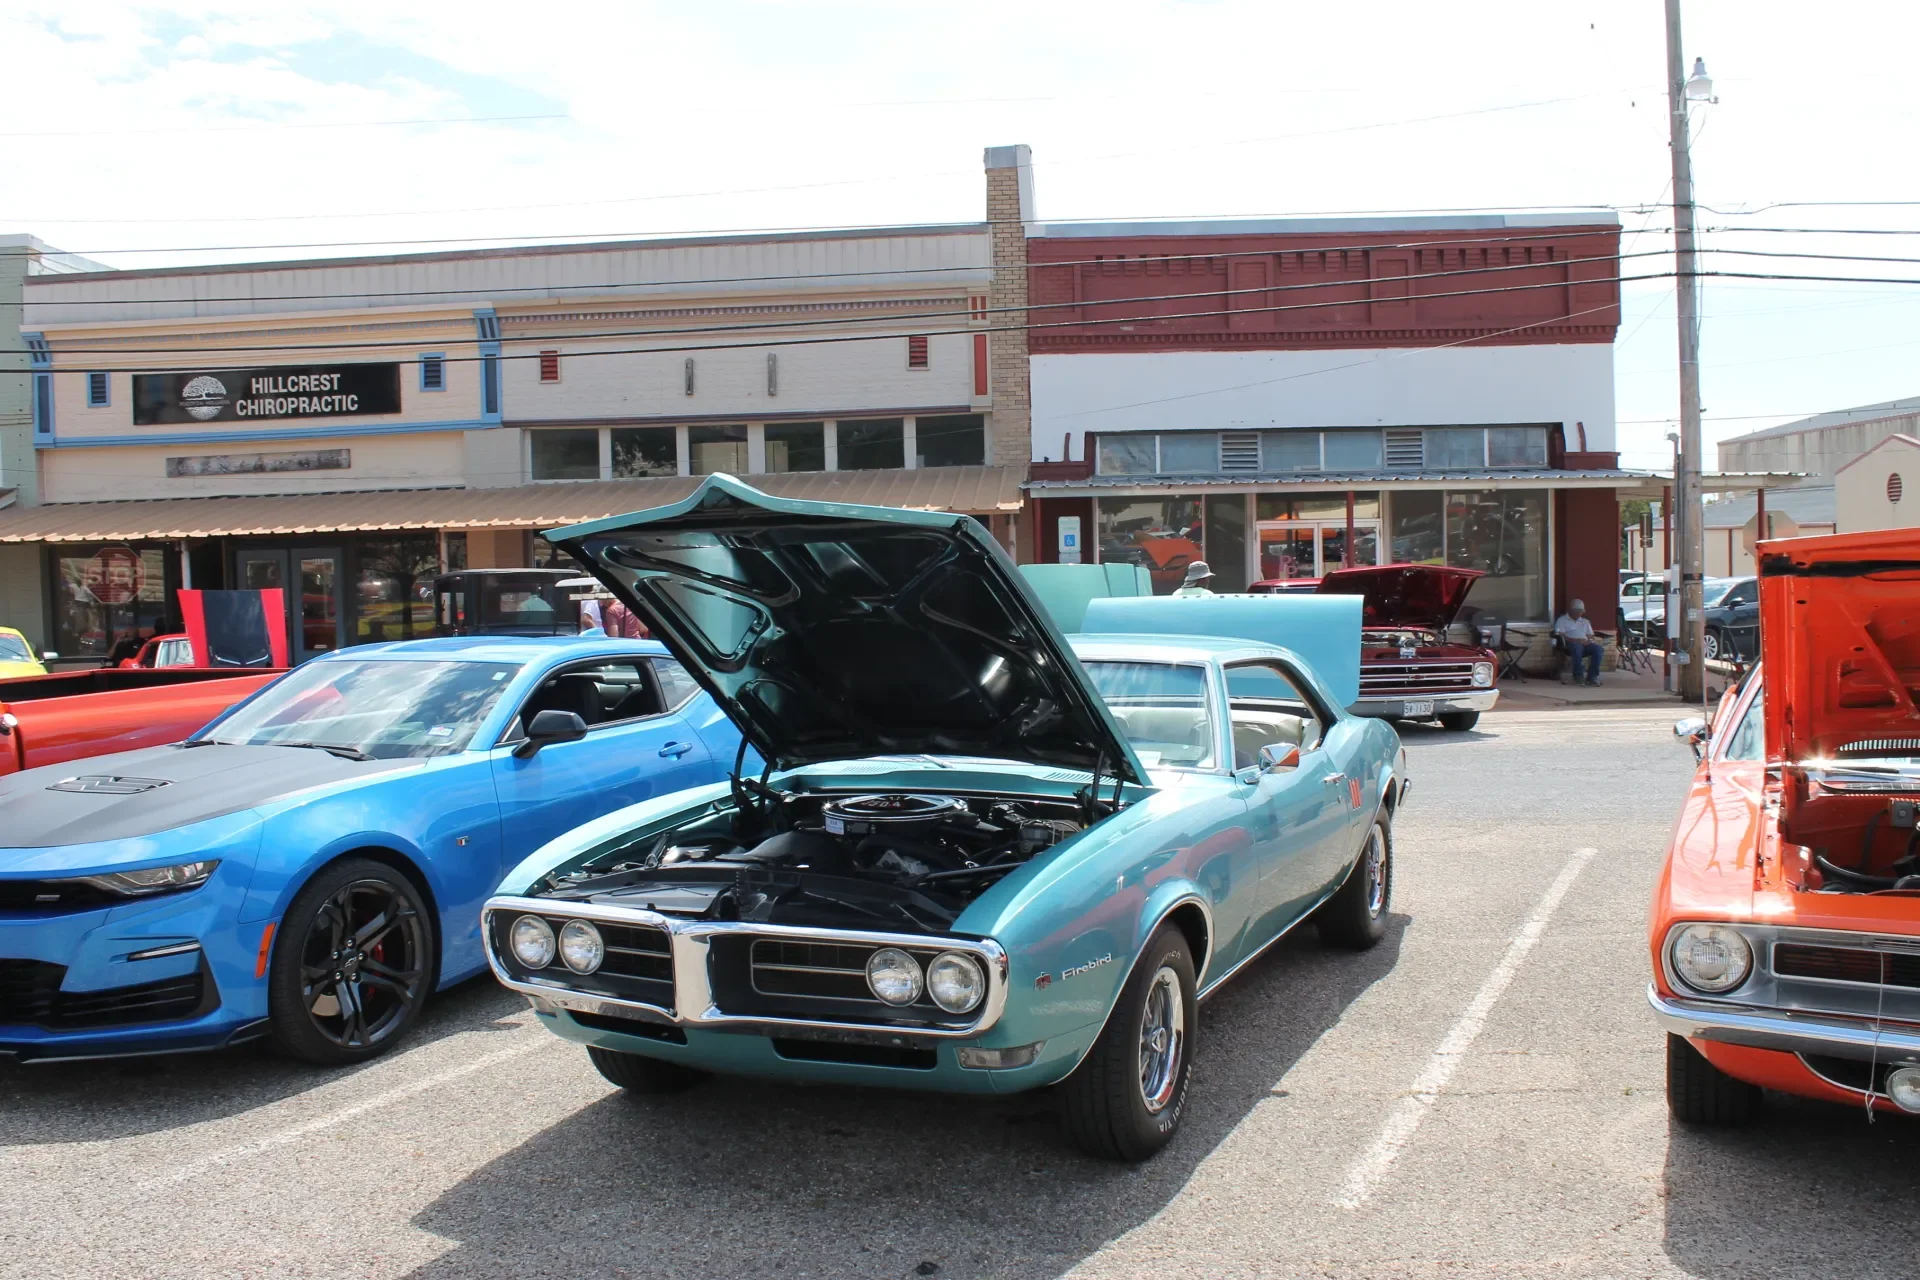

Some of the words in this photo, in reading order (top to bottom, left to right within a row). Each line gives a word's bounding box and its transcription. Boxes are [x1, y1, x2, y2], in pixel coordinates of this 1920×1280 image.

[252, 374, 341, 394] HILLCREST
[237, 395, 359, 416] CHIROPRACTIC
[1061, 952, 1112, 980] Firebird
